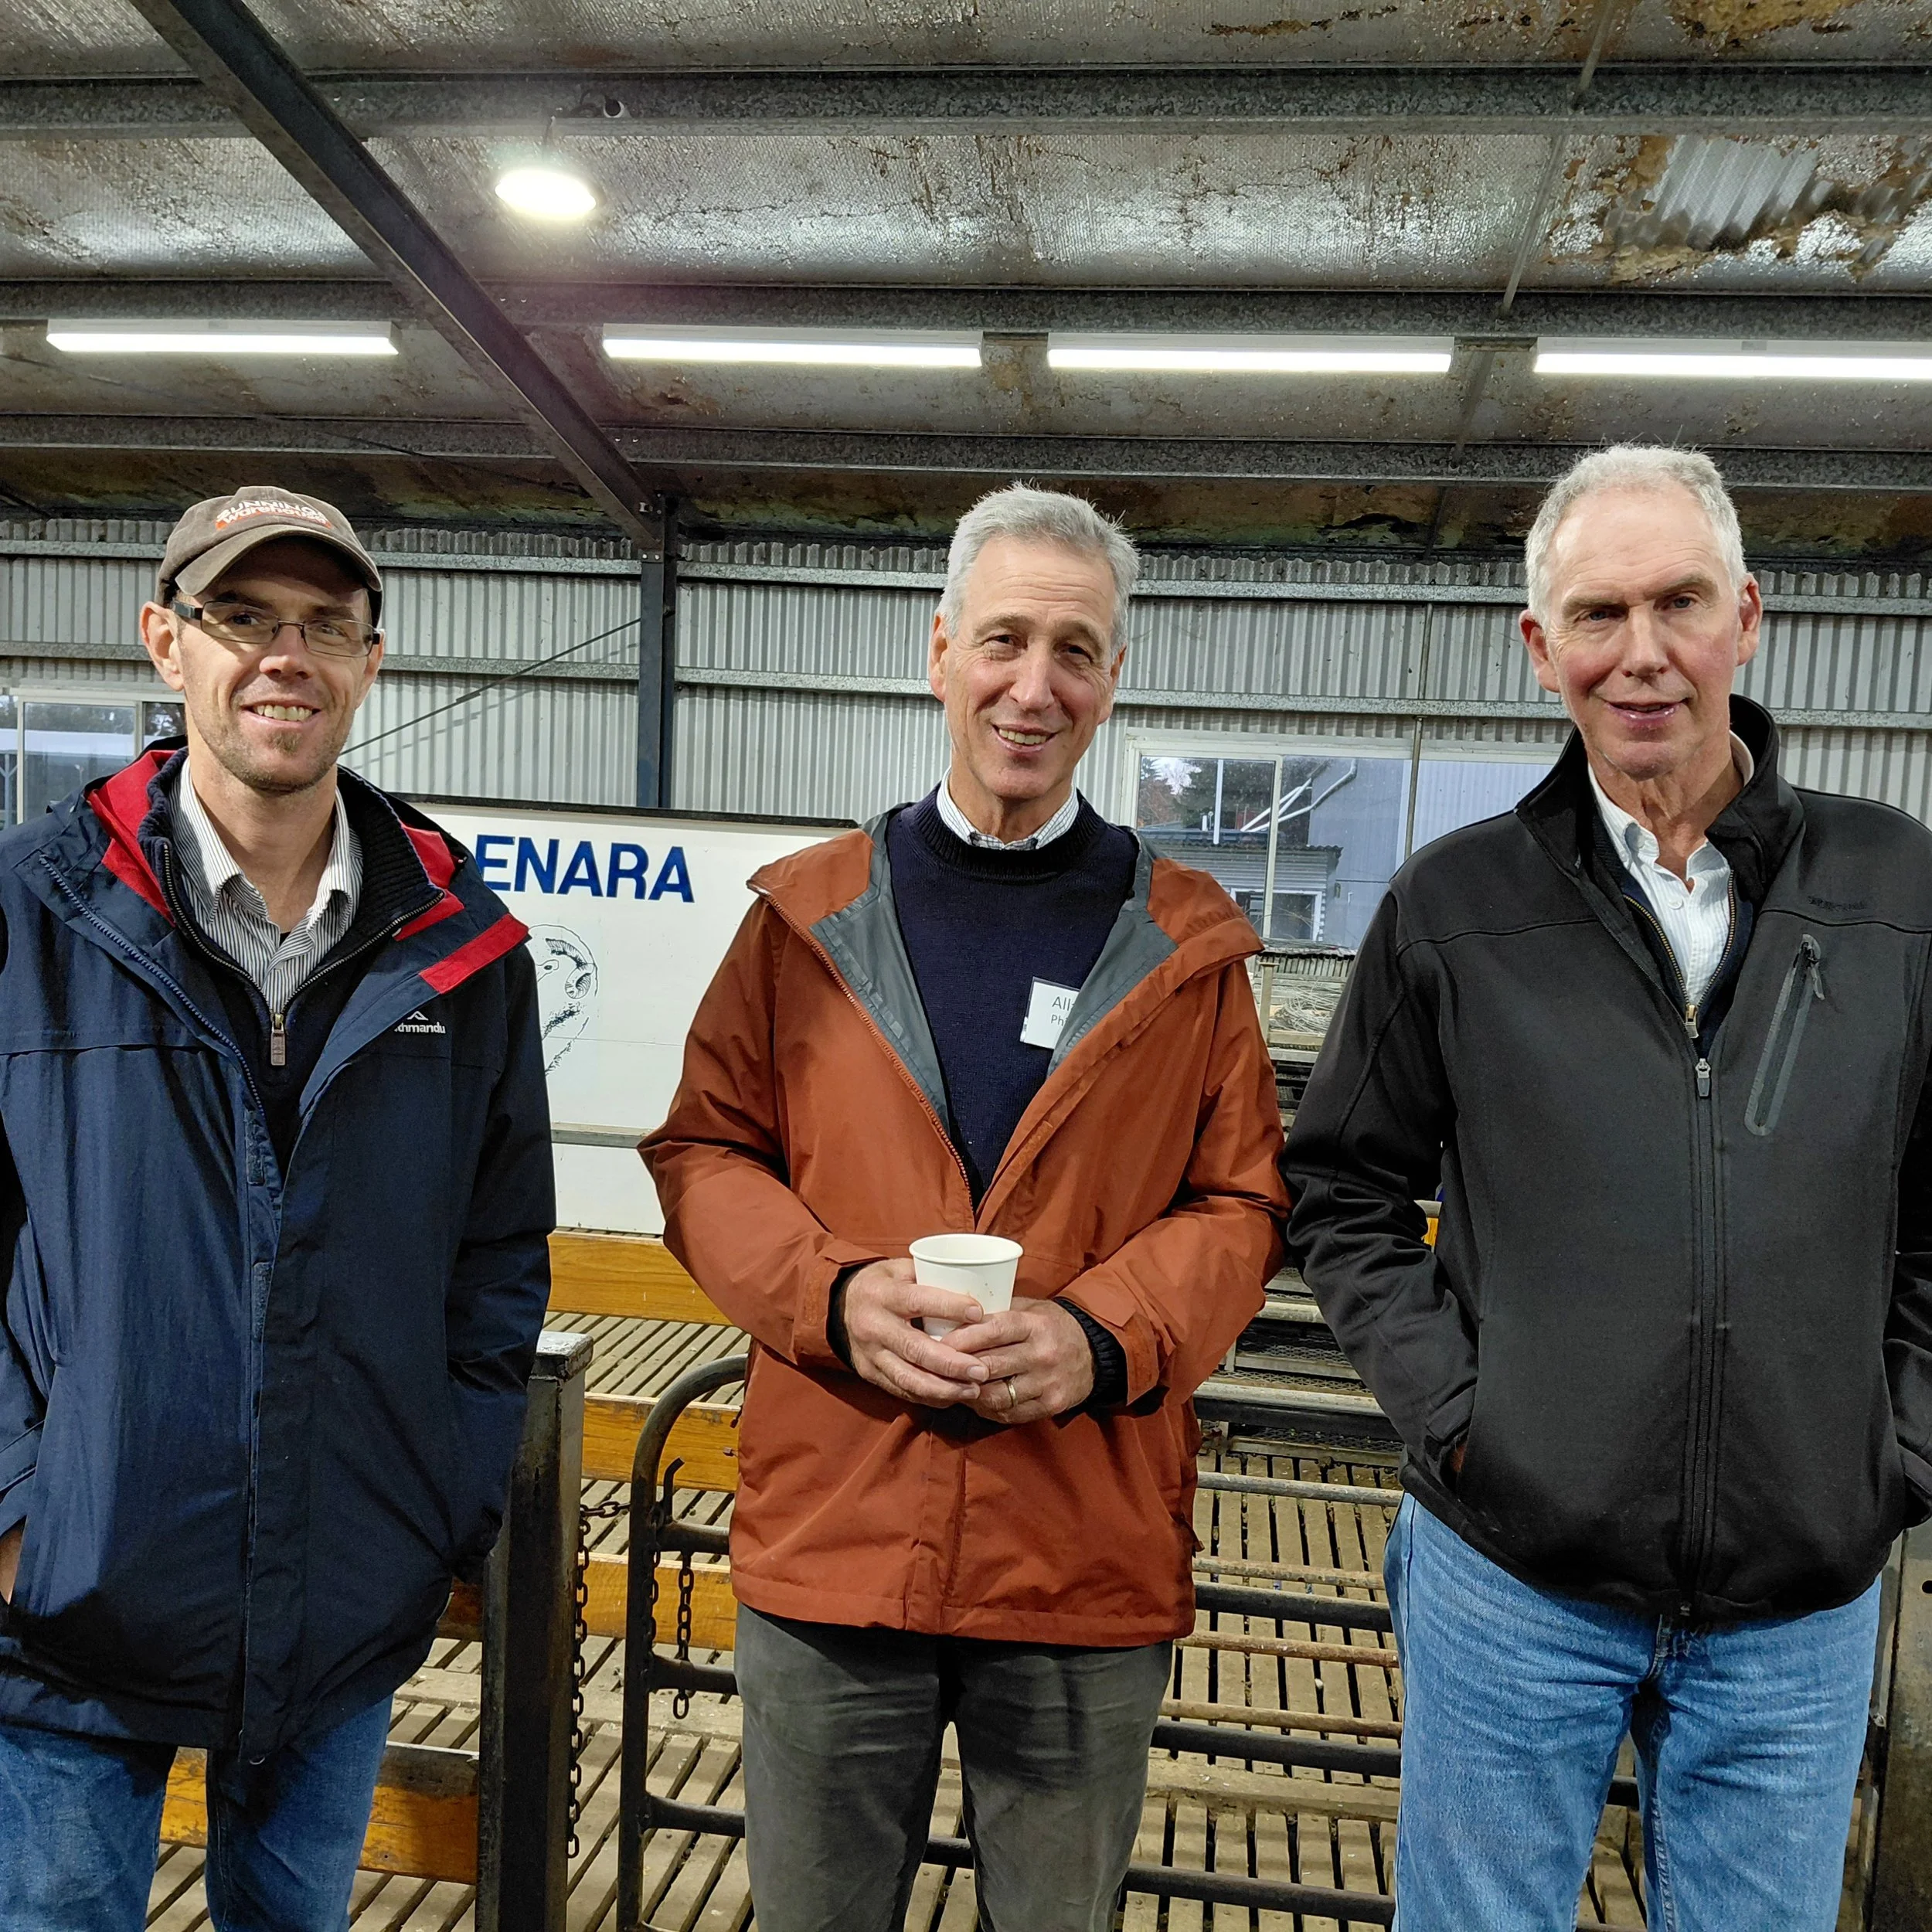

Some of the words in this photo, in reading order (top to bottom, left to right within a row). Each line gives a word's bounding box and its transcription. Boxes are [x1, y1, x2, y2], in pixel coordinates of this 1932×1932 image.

[477, 835, 694, 903] ENARA
[1052, 996, 1075, 1011] All
[1051, 1014, 1068, 1026] Ph
[394, 1021, 446, 1034] thmandu
